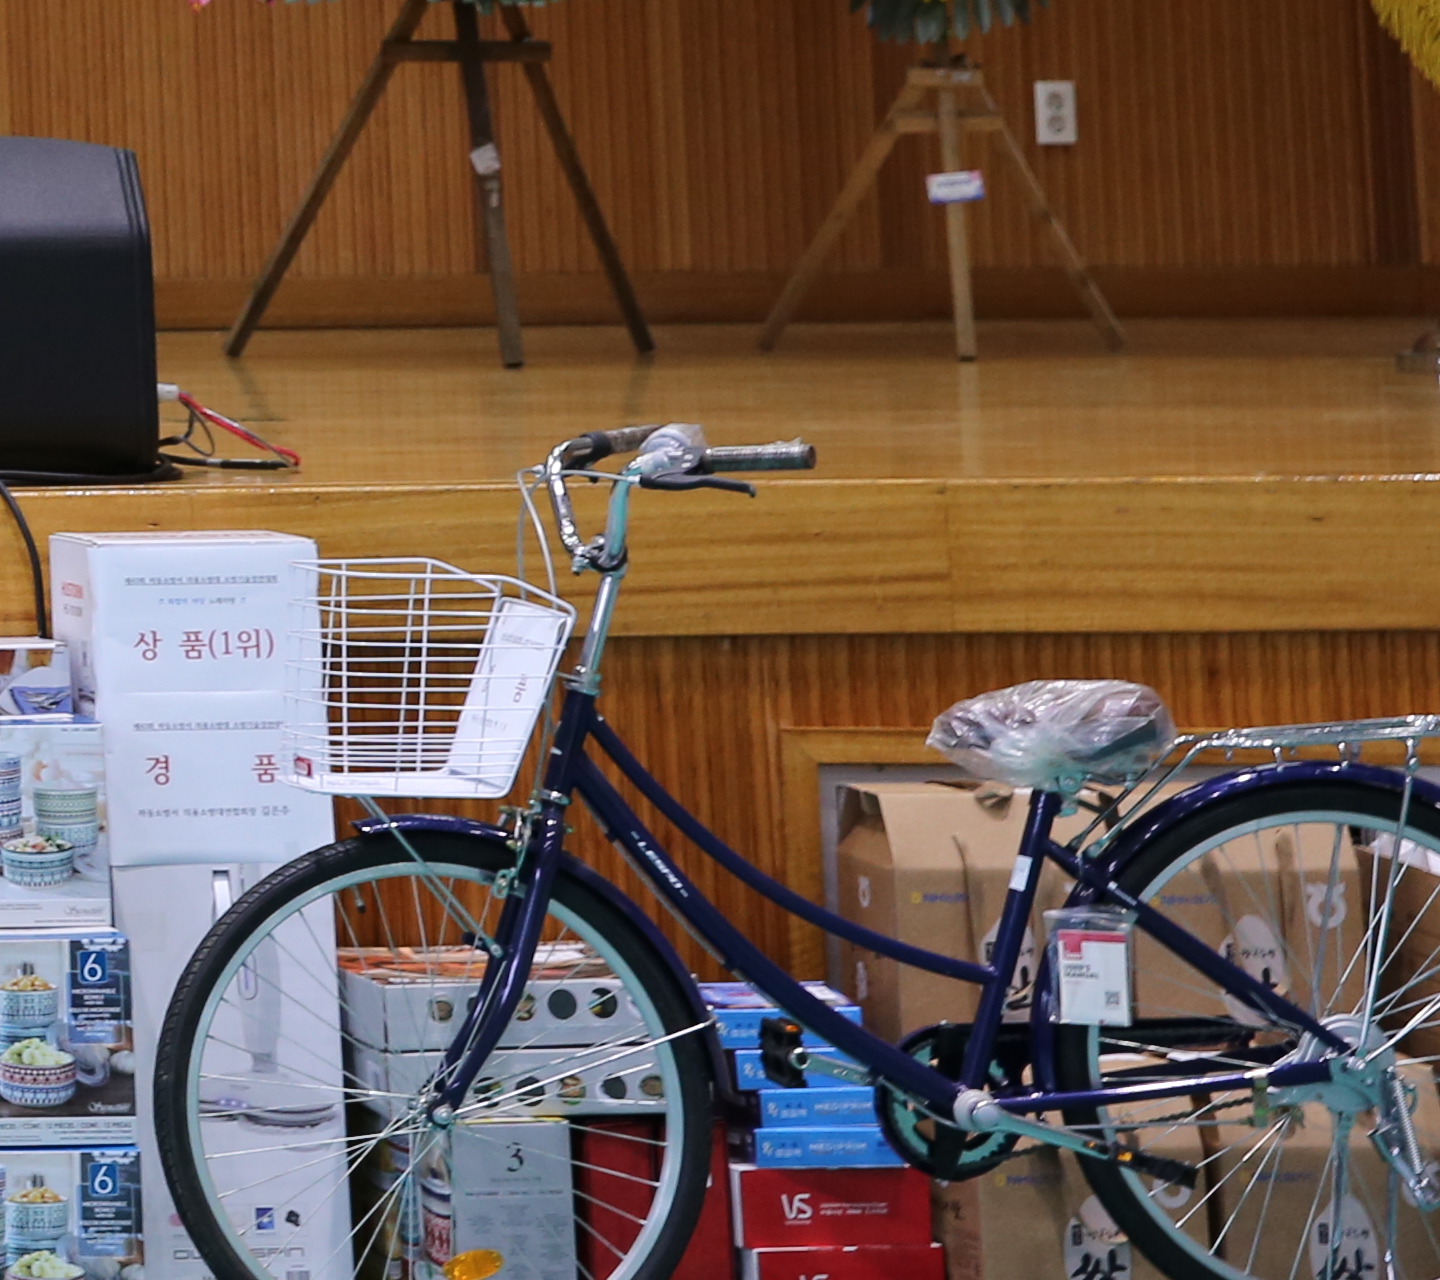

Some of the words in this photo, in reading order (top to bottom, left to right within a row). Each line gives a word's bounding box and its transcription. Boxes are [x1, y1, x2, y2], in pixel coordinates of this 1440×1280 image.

[133, 629, 164, 662] 상
[178, 628, 275, 661] 품(1위)
[144, 754, 171, 786] 경
[251, 754, 281, 784] 품
[82, 952, 103, 982] 6
[93, 1164, 113, 1193] 6
[781, 1192, 813, 1220] VS
